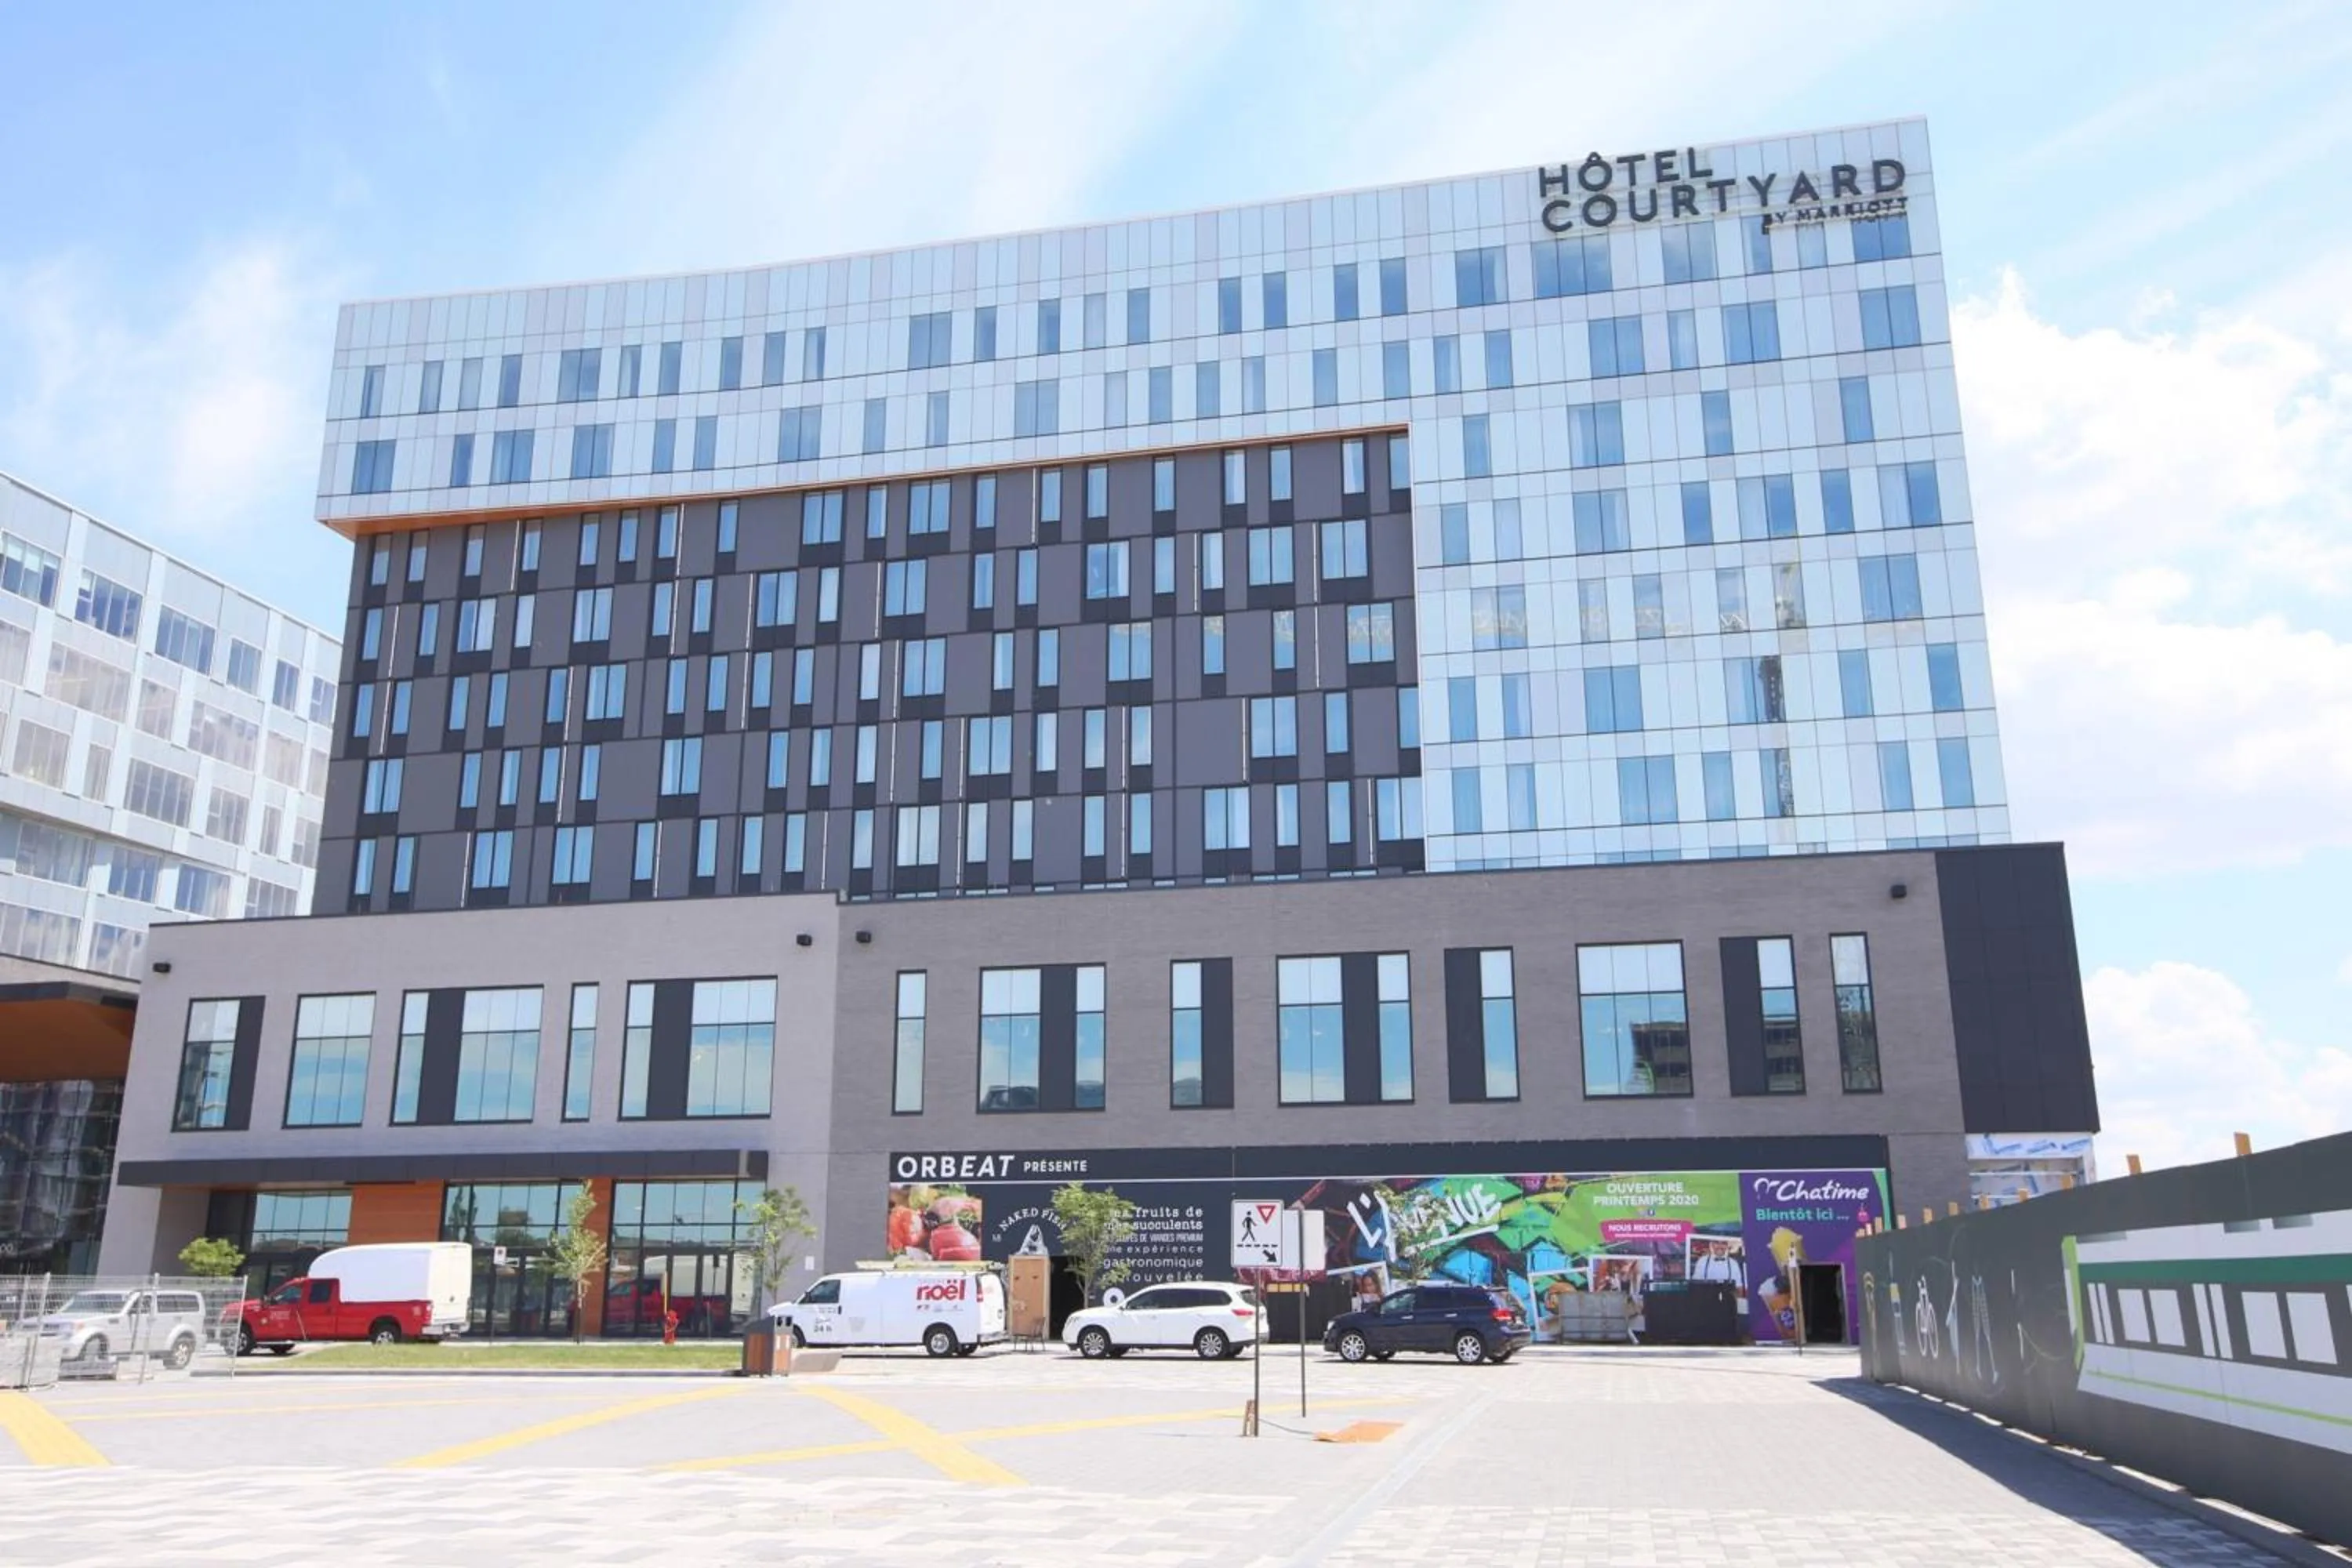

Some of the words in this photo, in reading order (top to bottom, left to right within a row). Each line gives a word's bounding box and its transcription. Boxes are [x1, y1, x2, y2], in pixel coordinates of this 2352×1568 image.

[1539, 147, 1713, 198] HÔTEL
[1541, 158, 1907, 233] COURTYARD
[1762, 212, 1787, 233] BY
[1797, 197, 1908, 222] MARRIOTT
[897, 1155, 1014, 1178] ORBEAT
[1023, 1159, 1088, 1174] PRÉSENTE
[1606, 1182, 1684, 1192] OUVERTURE
[1776, 1179, 1870, 1202] Chatime
[1593, 1195, 1666, 1206] PRINTEMPS
[1668, 1194, 1699, 1205] 2020
[1135, 1206, 1180, 1218] fruits
[1185, 1206, 1203, 1218] de
[1755, 1207, 1813, 1221] Bientôt
[1816, 1207, 1833, 1220] ici
[998, 1207, 1039, 1232] NAKED
[1134, 1219, 1203, 1230] succulents
[1127, 1245, 1203, 1255] expérience
[1103, 1258, 1203, 1269] gastronomique
[1102, 1272, 1203, 1282] rouvelée
[916, 1279, 965, 1301] noël
